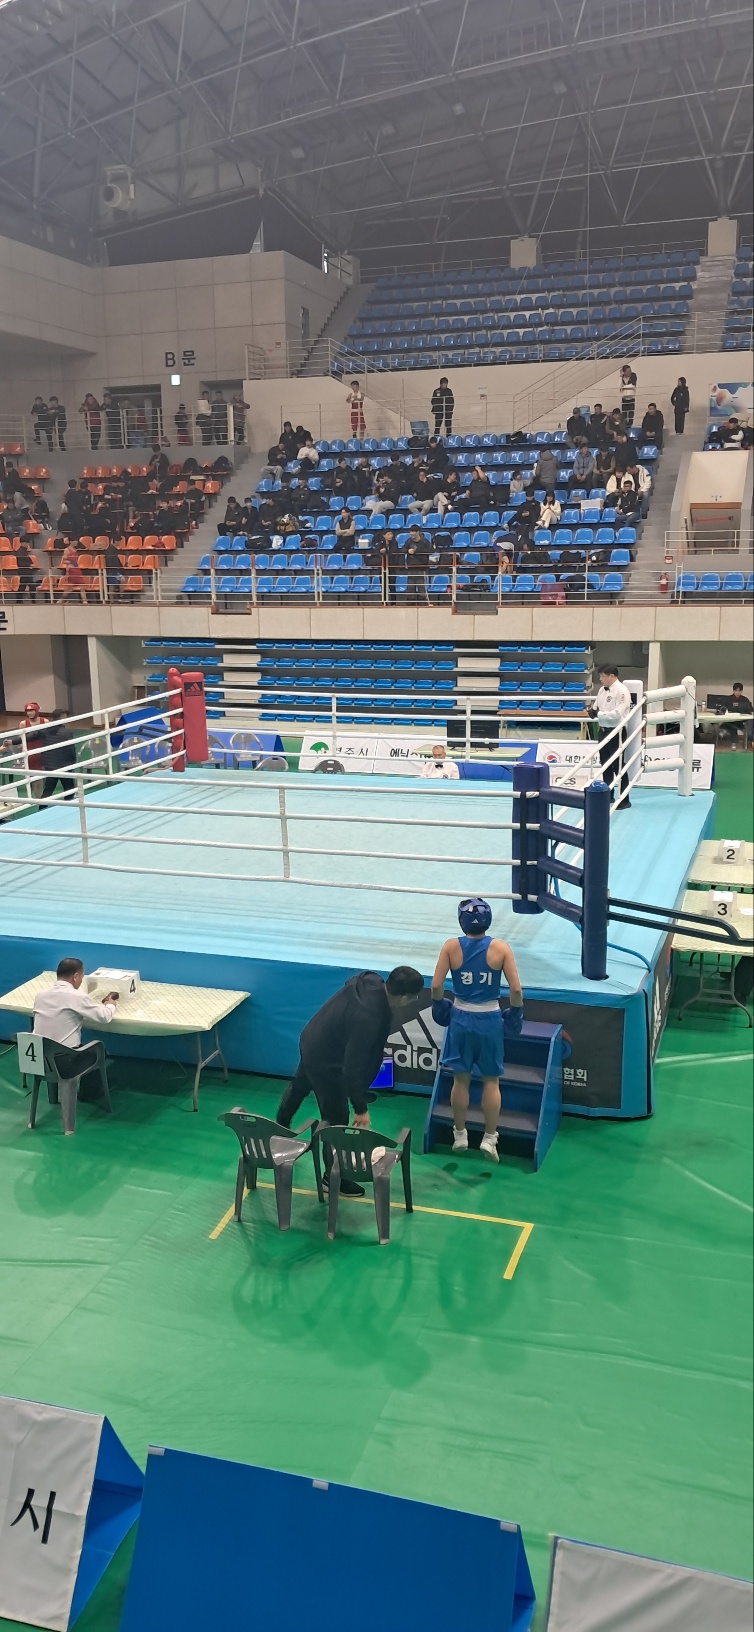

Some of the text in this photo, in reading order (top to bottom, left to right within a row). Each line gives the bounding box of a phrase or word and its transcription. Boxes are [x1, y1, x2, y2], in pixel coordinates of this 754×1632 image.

[726, 848, 736, 860] 2
[717, 902, 728, 916] 3
[129, 979, 136, 993] 4
[25, 1042, 37, 1062] 4
[9, 1487, 57, 1546] 시
